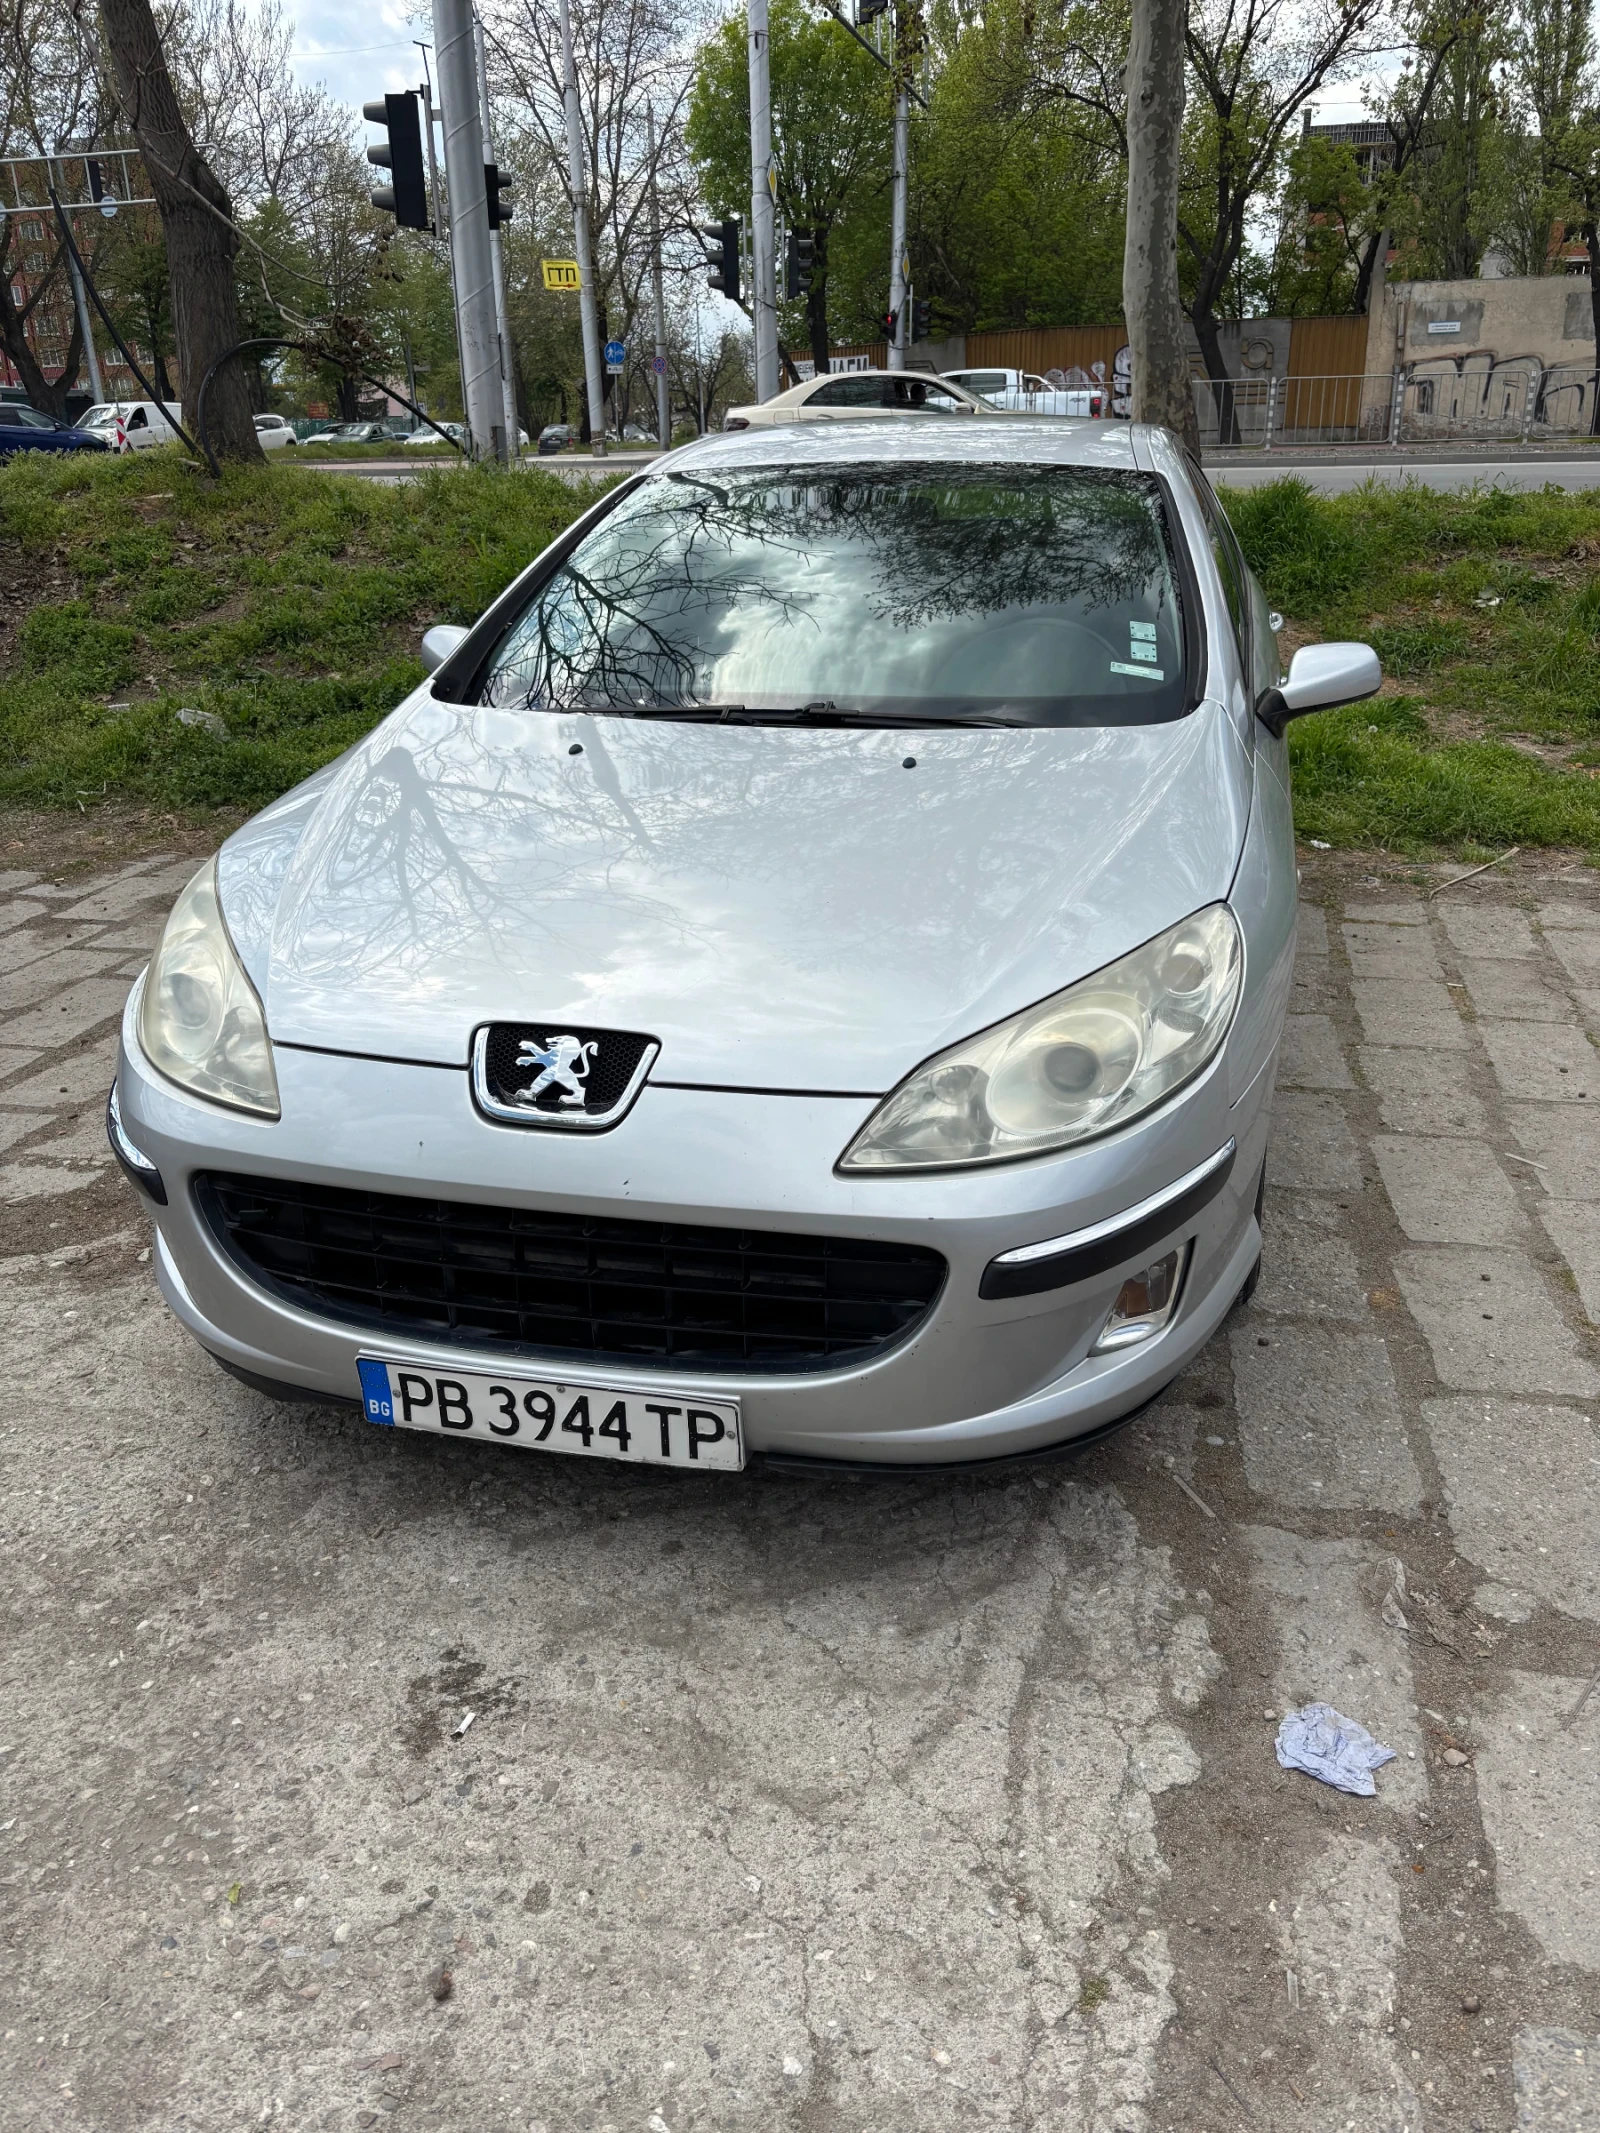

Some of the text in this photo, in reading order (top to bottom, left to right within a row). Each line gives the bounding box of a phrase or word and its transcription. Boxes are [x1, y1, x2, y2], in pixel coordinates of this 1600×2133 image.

[547, 267, 576, 282] ГТП
[369, 1398, 390, 1417] BG
[397, 1372, 725, 1460] PB 3944 TP
